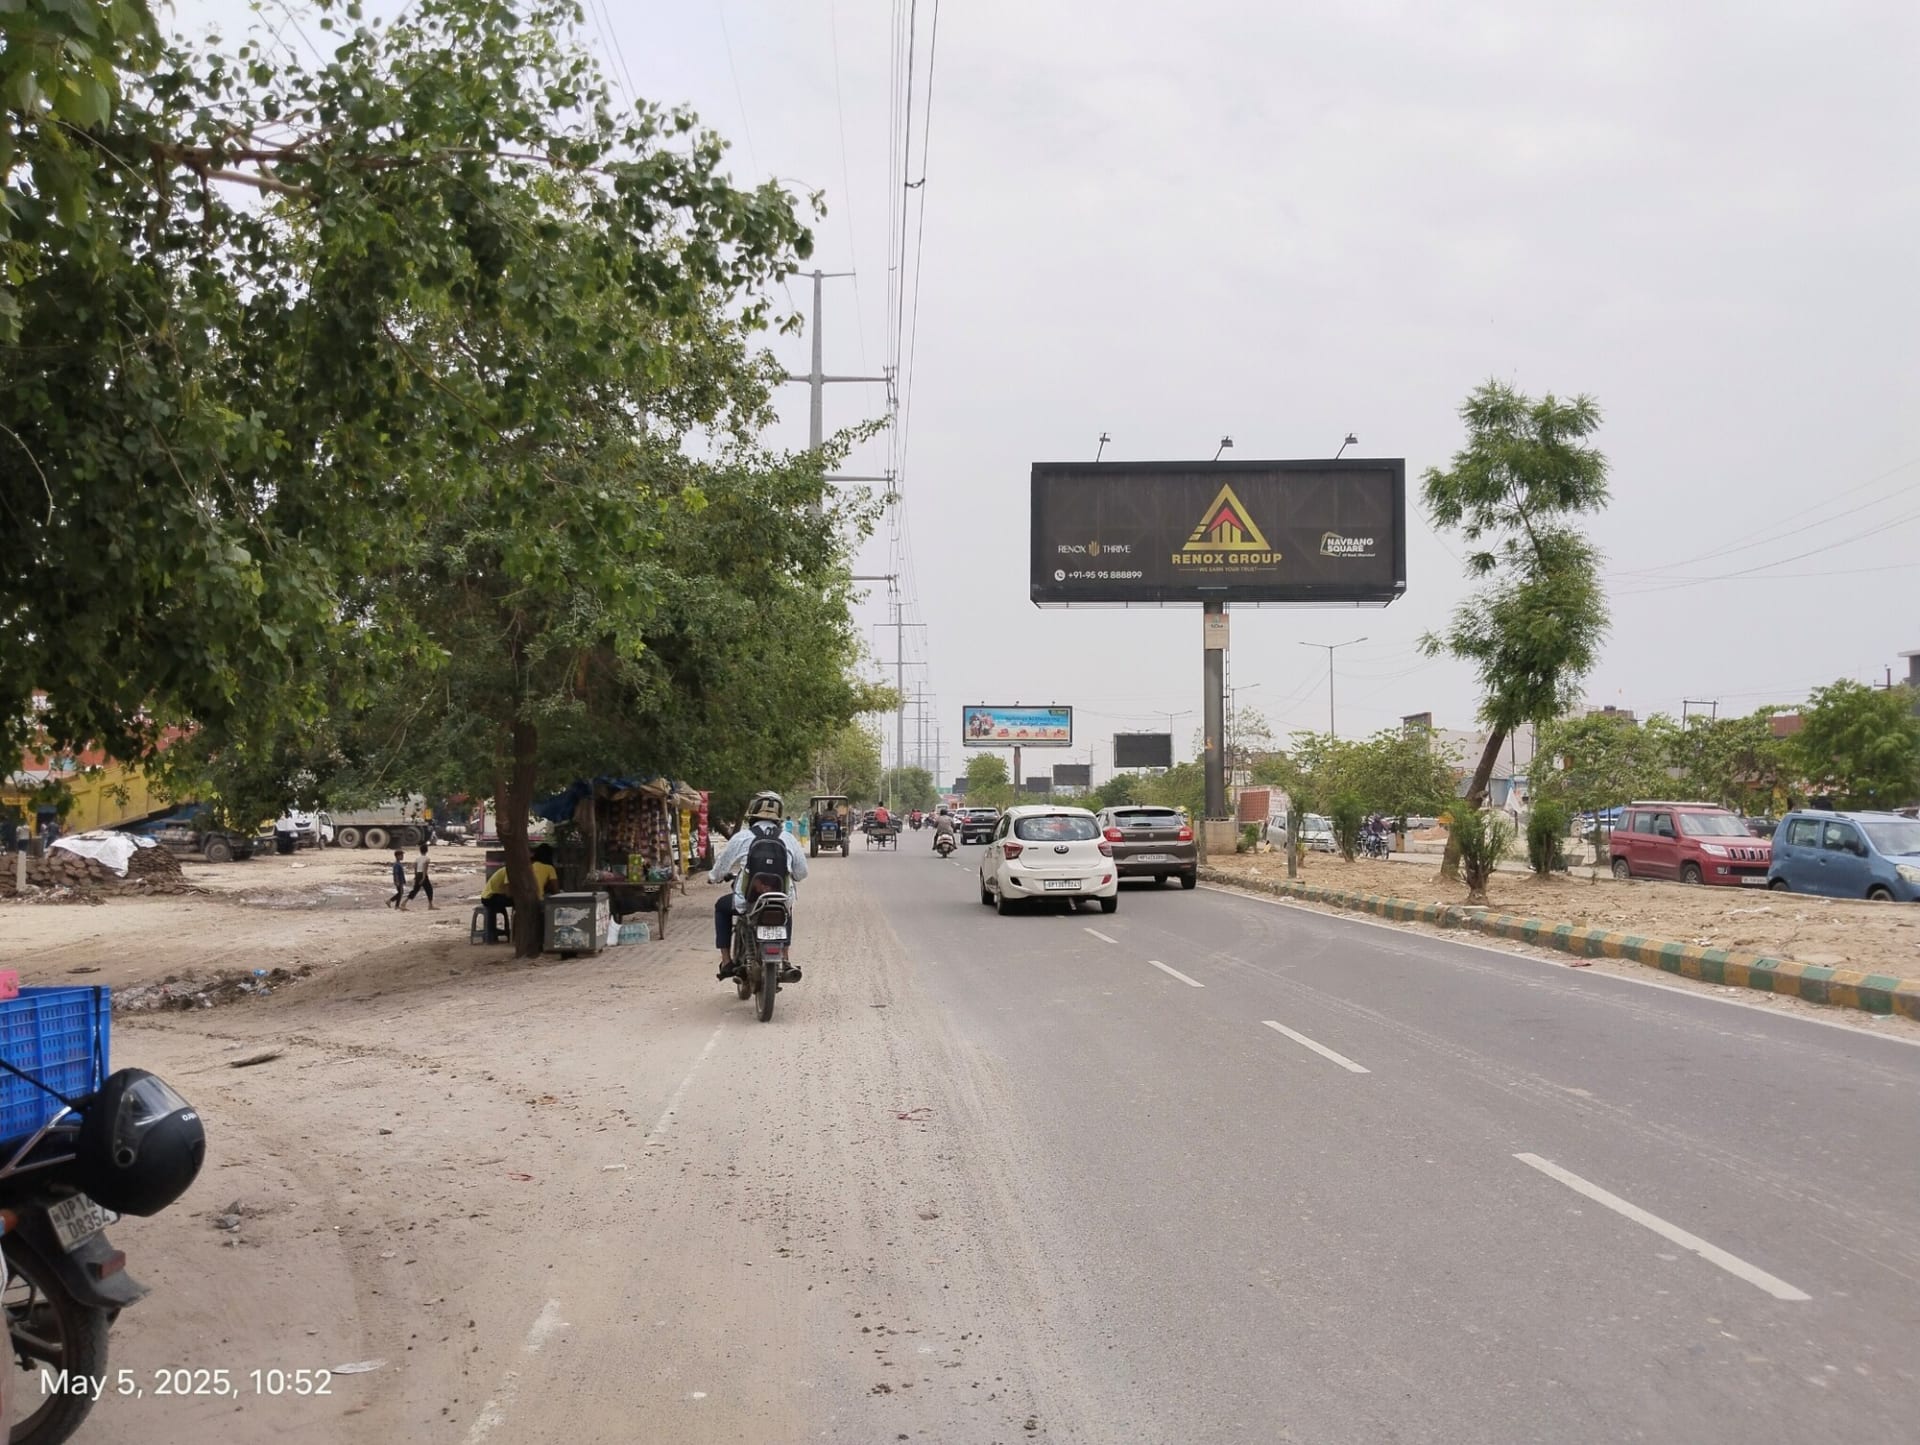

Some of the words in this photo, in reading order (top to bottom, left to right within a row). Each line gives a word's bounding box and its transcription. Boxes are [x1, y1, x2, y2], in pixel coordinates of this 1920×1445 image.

[1327, 537, 1374, 546] NAVRANG
[1058, 544, 1087, 553] RENOX
[1103, 544, 1132, 553] THRIVE
[1171, 553, 1224, 564] RENOX
[1228, 553, 1283, 564] GROUP
[1068, 571, 1096, 579] +91-95
[1097, 570, 1109, 579] 95
[1110, 570, 1143, 579] 888899
